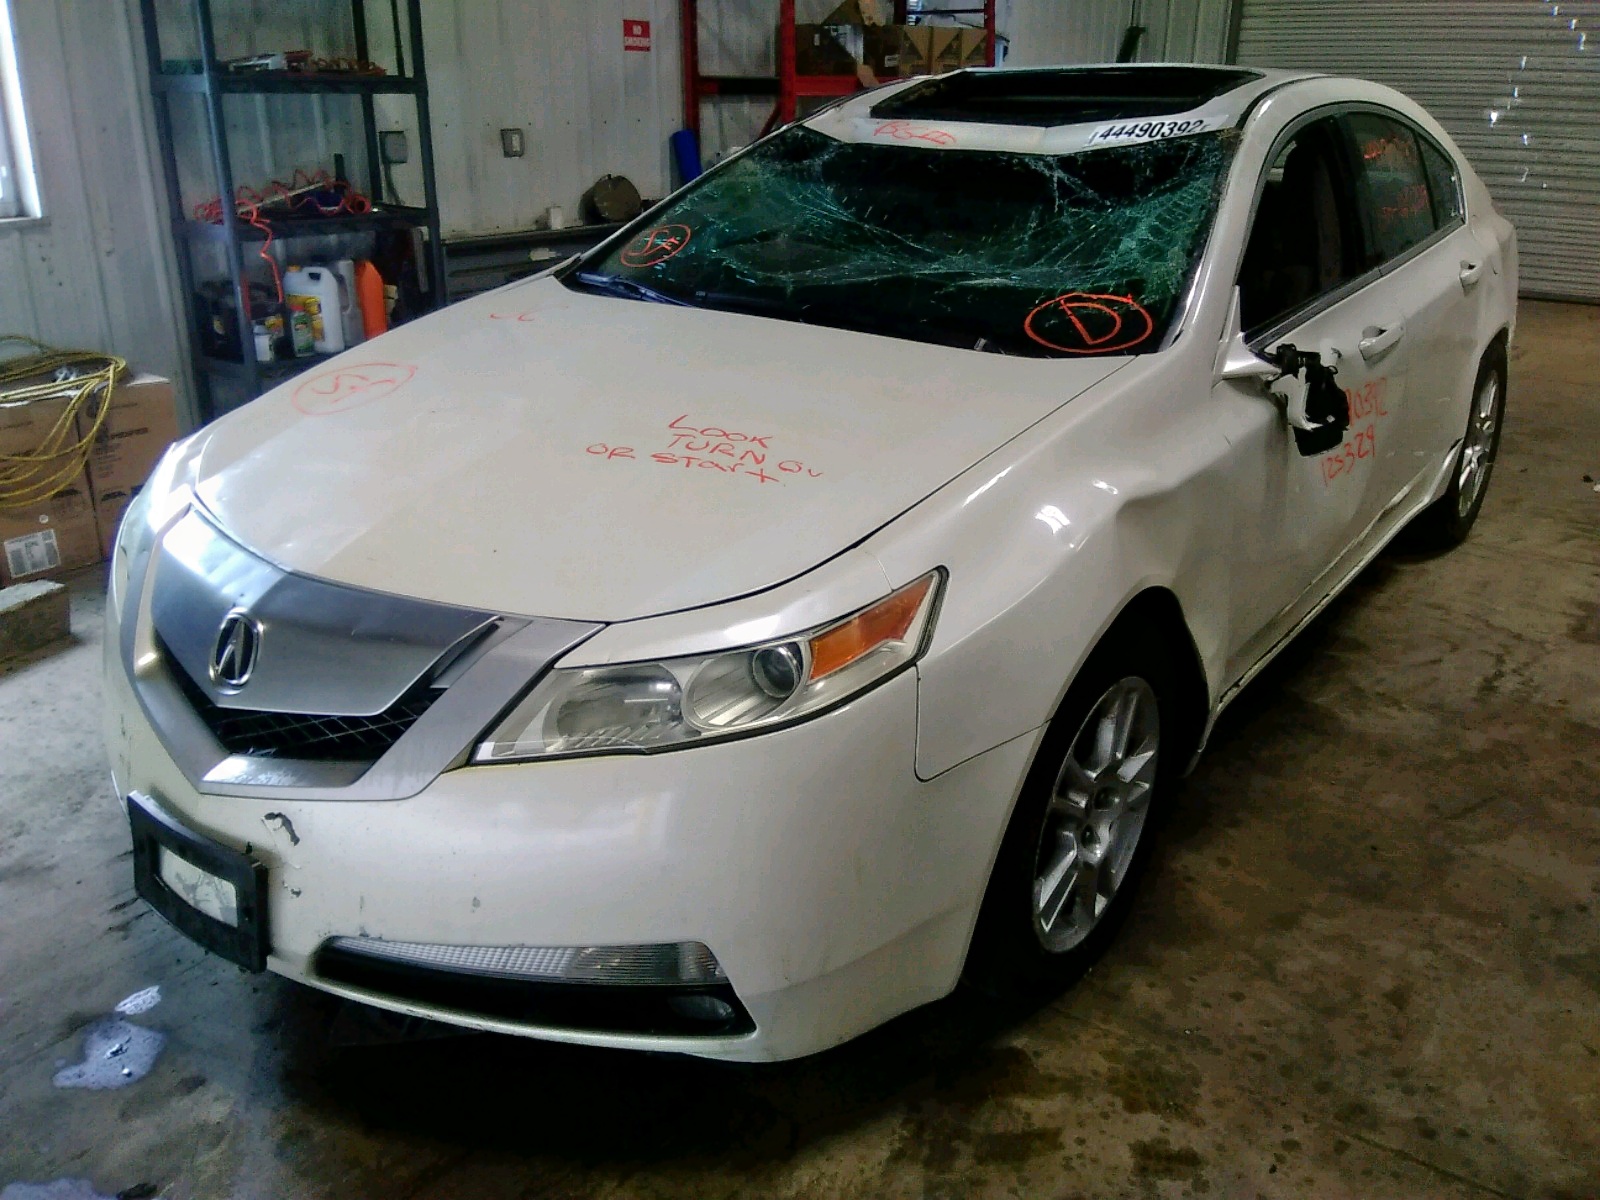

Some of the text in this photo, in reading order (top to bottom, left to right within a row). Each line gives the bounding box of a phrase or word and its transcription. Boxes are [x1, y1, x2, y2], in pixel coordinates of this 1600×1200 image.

[632, 24, 643, 36] NO
[668, 414, 774, 449] LOOK
[585, 442, 637, 461] OR
[667, 433, 766, 465] TURN
